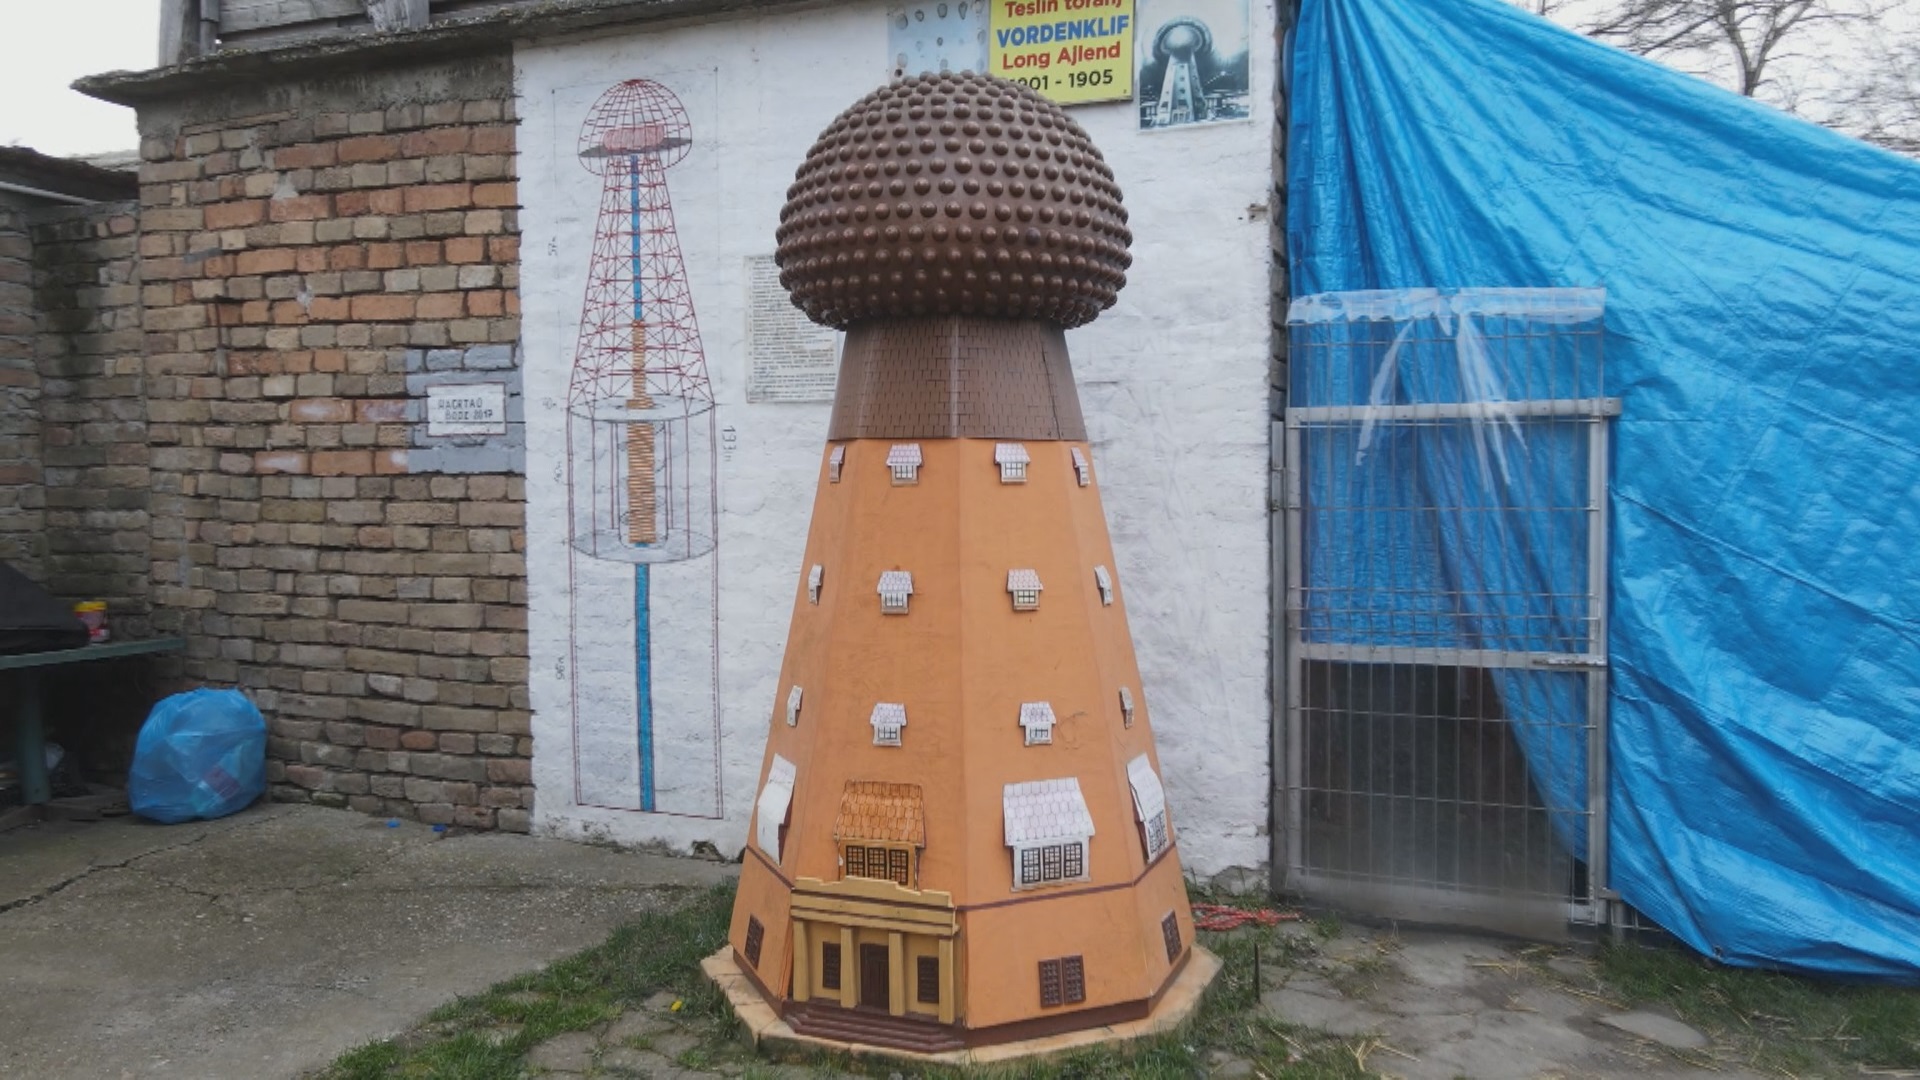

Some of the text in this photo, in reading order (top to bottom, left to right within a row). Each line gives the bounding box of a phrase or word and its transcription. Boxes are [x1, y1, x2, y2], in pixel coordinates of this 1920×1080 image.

[1005, 0, 1058, 17] Teslin
[997, 15, 1129, 48] VORDENKLIF
[1003, 41, 1121, 69] Long Ajlend
[1010, 75, 1048, 90] 01
[1069, 69, 1113, 88] 1905
